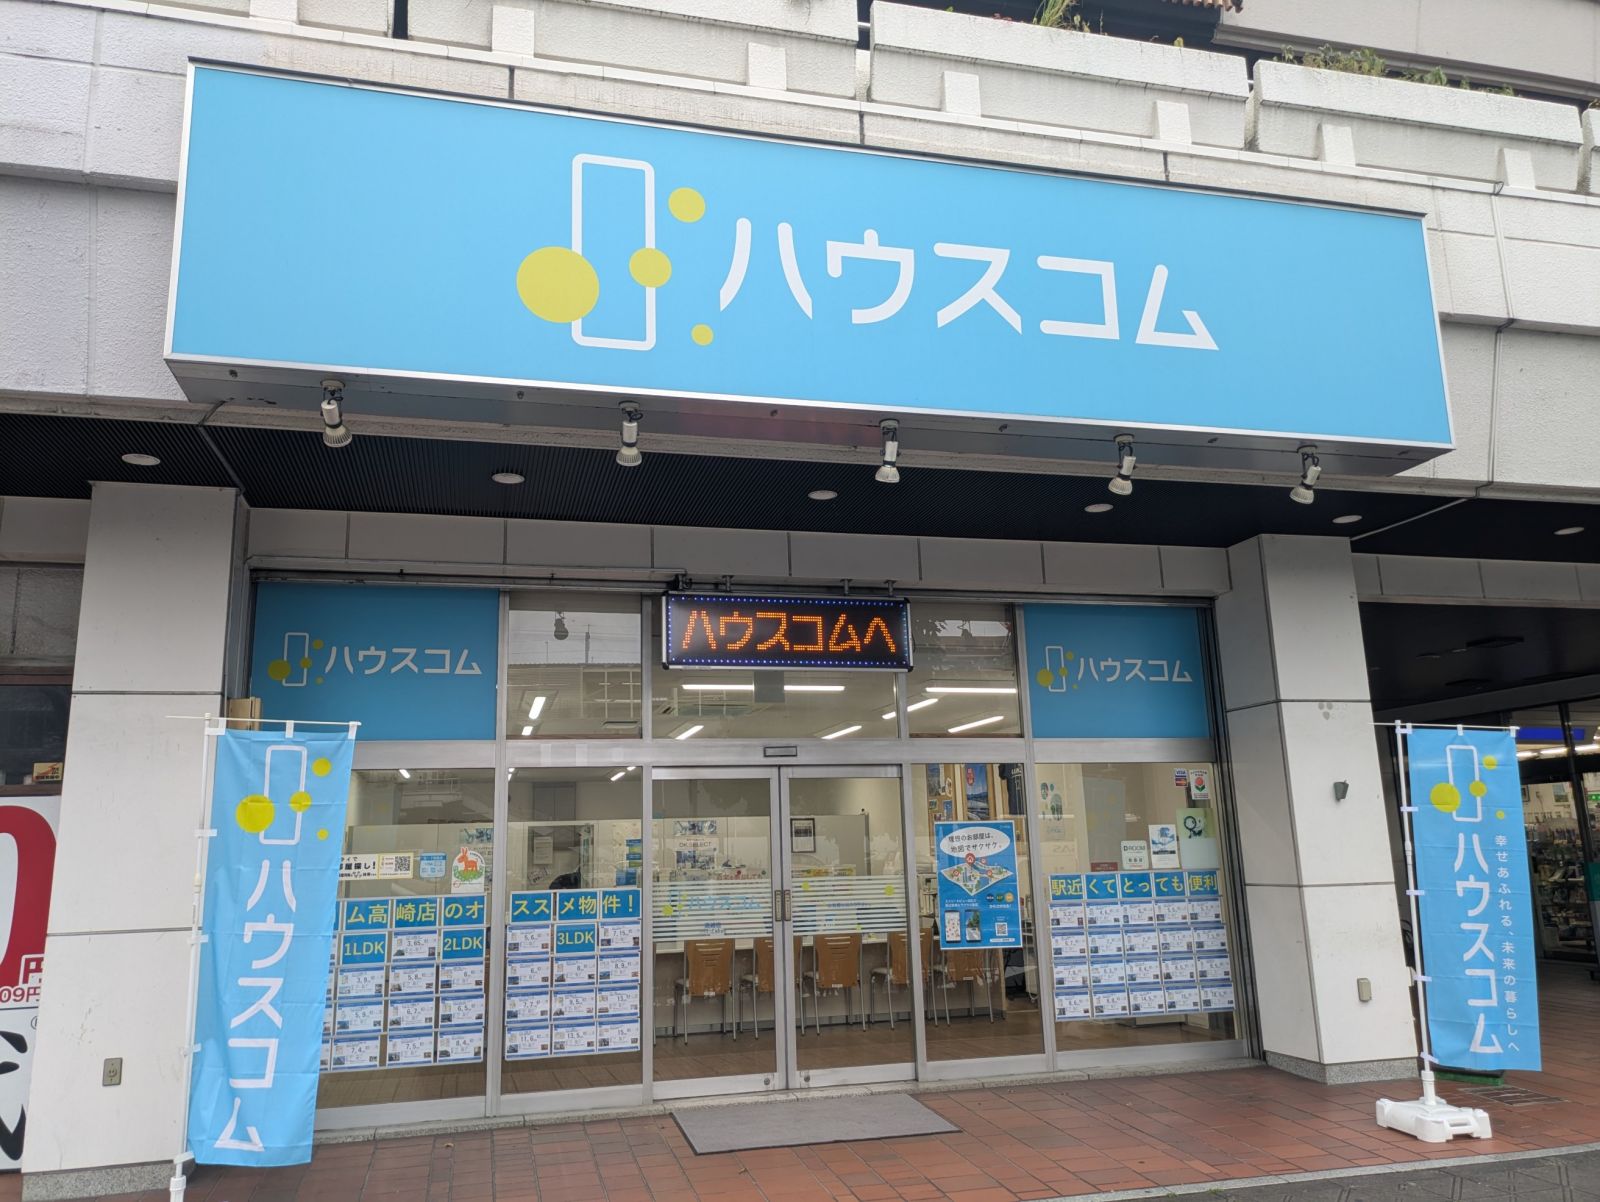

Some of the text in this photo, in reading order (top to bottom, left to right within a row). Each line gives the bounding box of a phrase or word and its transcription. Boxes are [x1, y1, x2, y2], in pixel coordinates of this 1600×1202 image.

[720, 217, 1219, 350] ハウスコム
[682, 610, 896, 653] ハウスコムへ
[325, 646, 482, 675] ハウスコム
[1078, 657, 1193, 682] ハウスコム
[1051, 875, 1218, 896] 駅近くてとっても便利
[344, 941, 384, 956] 1LDK
[443, 936, 483, 951] 2LDK
[557, 931, 595, 945] 3LDK
[1454, 832, 1503, 1053] ハウスコム
[1495, 835, 1520, 1052] 幸せあふれる、未来の暮らしへ
[213, 860, 297, 1152] ハウスコム
